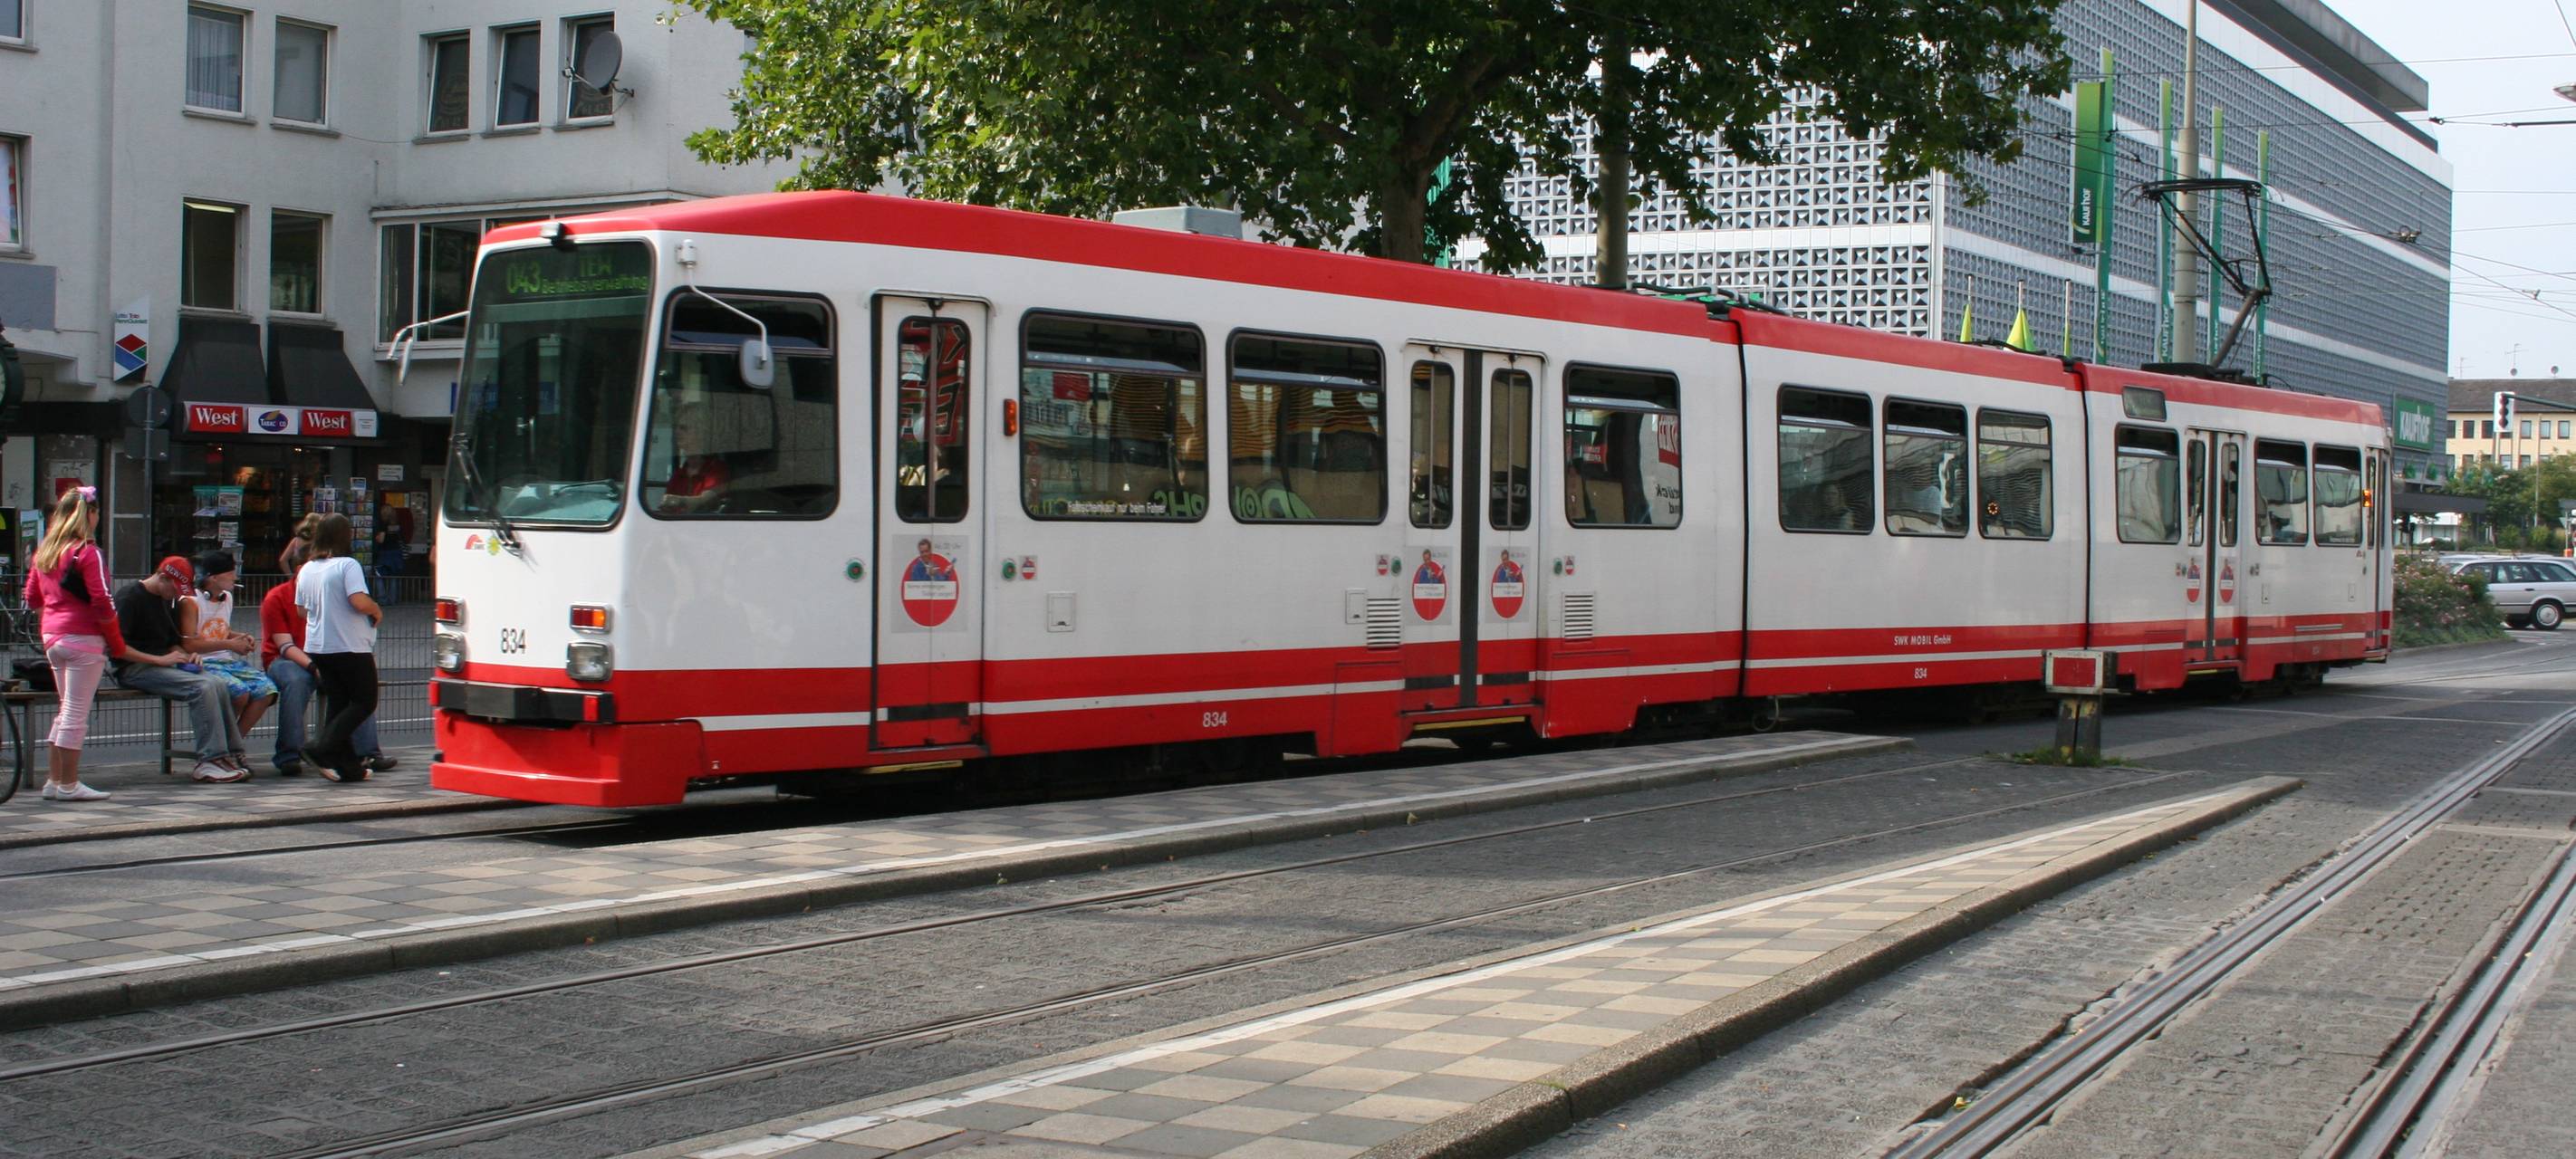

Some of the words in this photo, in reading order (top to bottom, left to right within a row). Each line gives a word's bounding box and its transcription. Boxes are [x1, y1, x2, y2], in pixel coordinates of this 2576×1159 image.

[506, 260, 541, 293] 043
[196, 407, 237, 426] West
[307, 413, 347, 430] West
[501, 627, 525, 654] 834
[1894, 636, 1908, 646] SWK
[1911, 635, 1932, 646] MOBIL
[1934, 635, 1951, 645] GmbH
[1914, 667, 1927, 679] 834
[1203, 711, 1227, 727] 834
